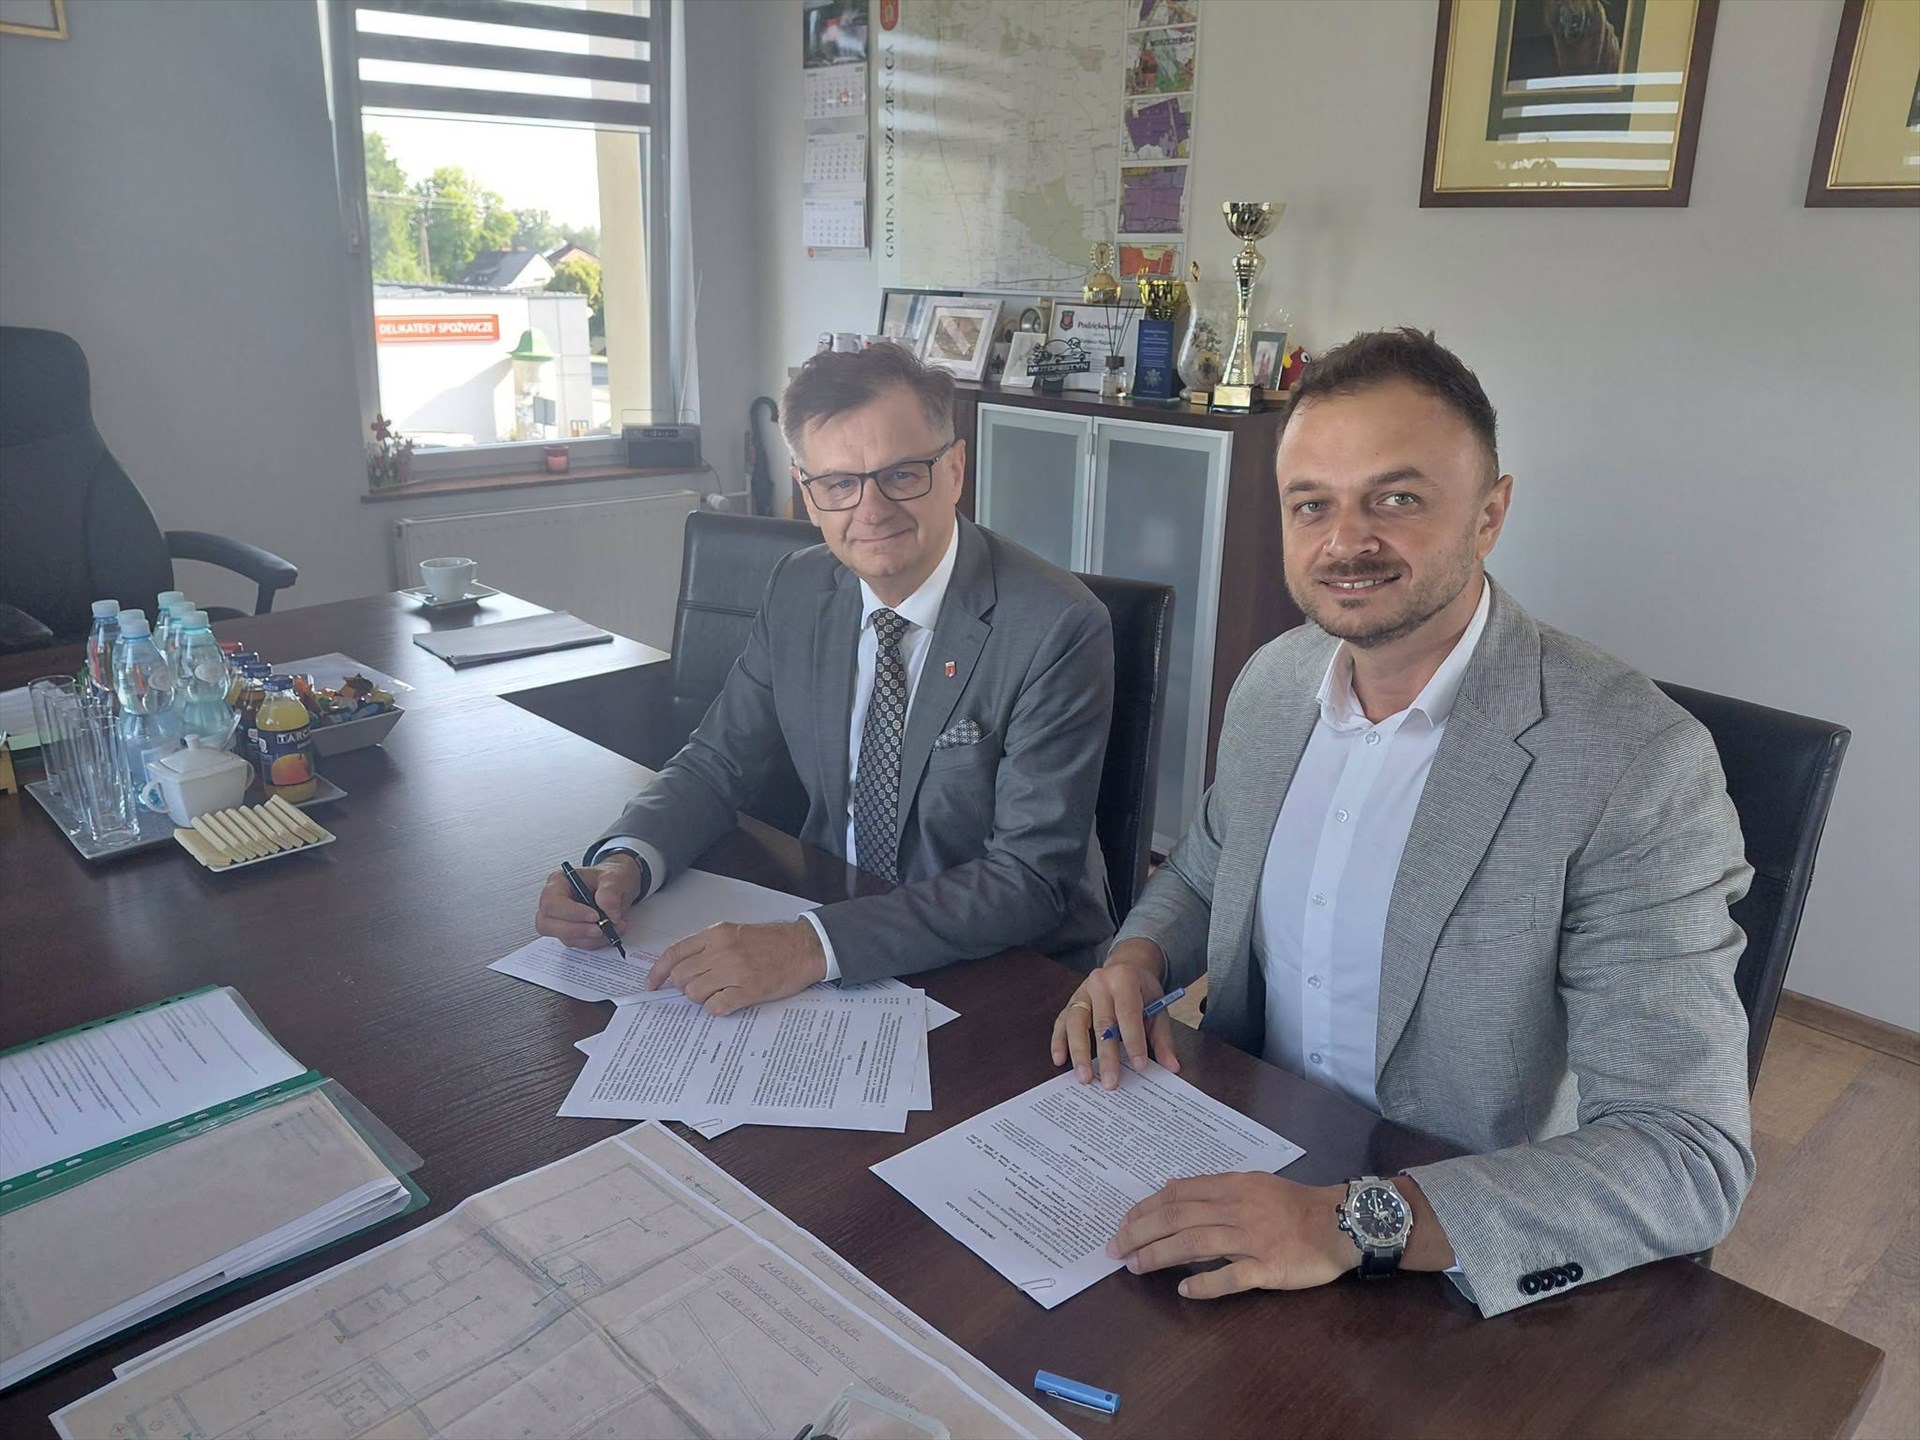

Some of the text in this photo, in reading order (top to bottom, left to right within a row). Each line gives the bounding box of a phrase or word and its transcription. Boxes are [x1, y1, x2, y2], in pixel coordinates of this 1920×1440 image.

[885, 44, 895, 259] GMINA MOSZCZENICA
[379, 321, 494, 334] DELIKATESY SPOŻYWCZE
